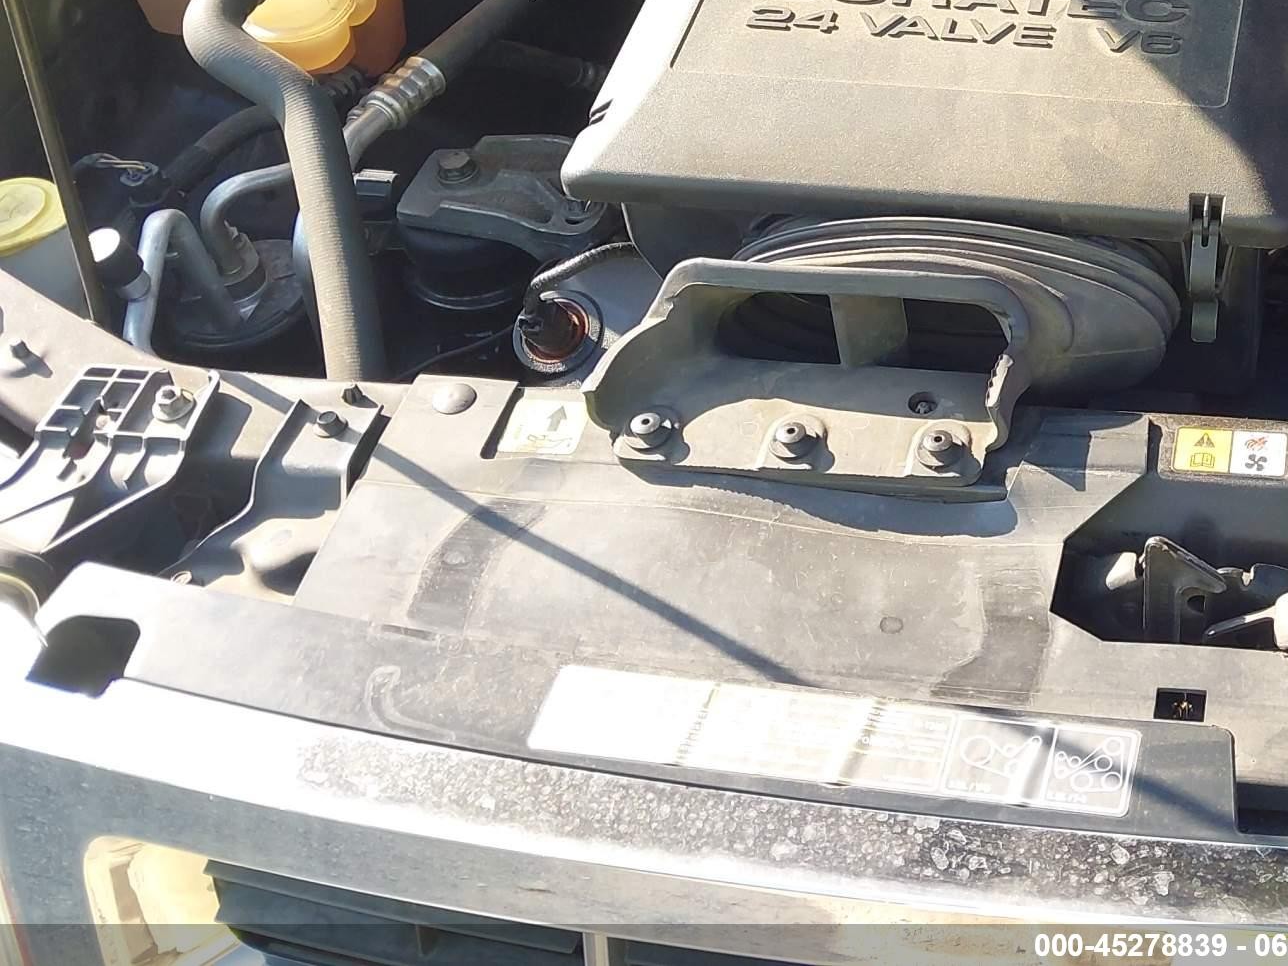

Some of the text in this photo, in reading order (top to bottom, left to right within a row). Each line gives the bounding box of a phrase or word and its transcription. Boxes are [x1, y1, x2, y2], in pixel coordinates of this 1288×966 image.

[746, 5, 1185, 55] 24 VALVE V6
